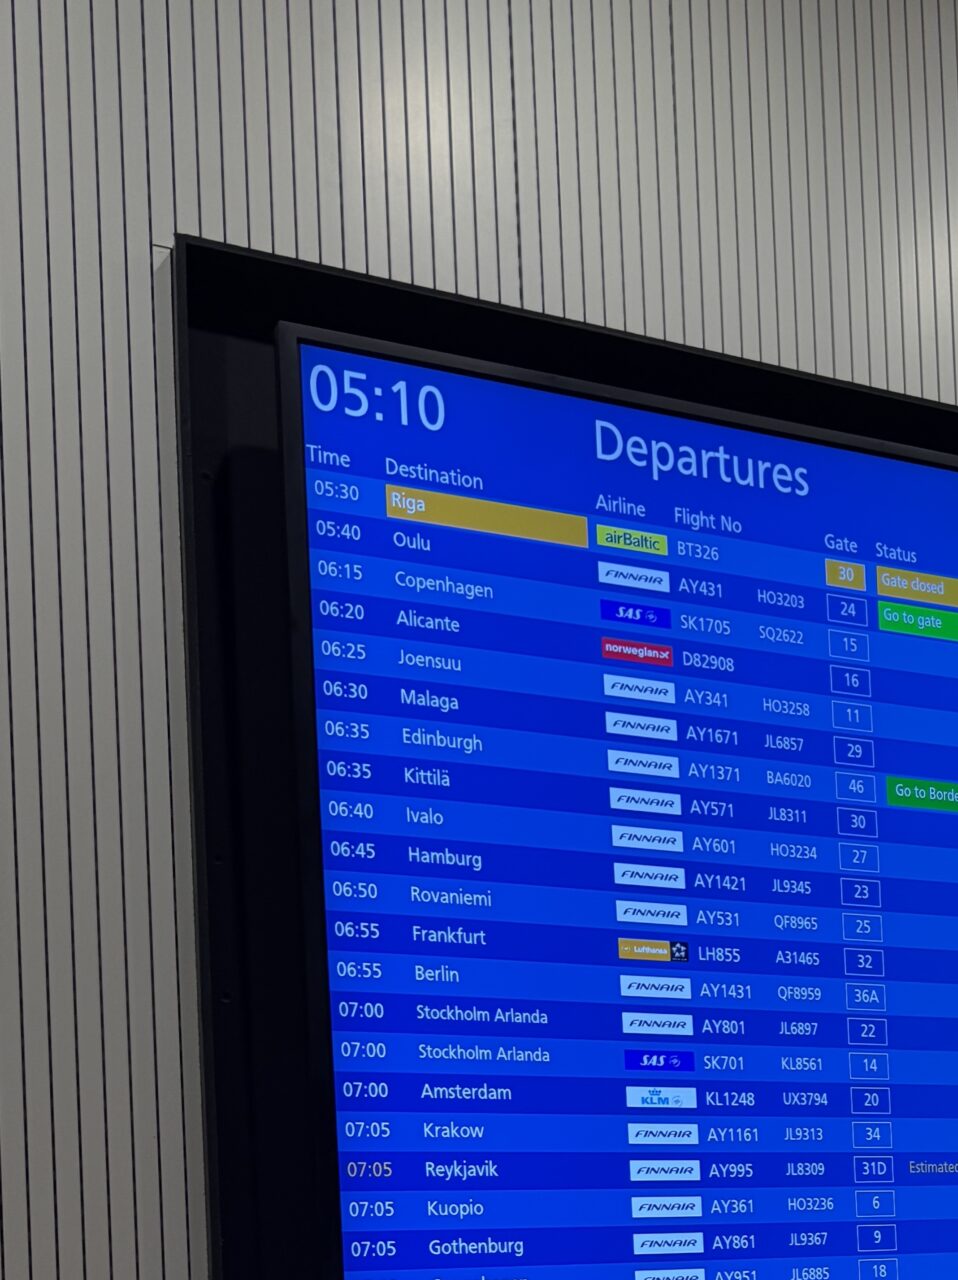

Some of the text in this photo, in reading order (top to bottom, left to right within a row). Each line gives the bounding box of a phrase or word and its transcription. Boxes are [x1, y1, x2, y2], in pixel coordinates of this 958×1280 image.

[309, 364, 446, 432] 05:10
[595, 419, 810, 497] Departures
[305, 444, 917, 563] Time Destination Airline Flight No Gate Status
[314, 479, 945, 595] 05:30 Riga airBaltic BT326 30 Gate closed
[316, 519, 942, 629] 05:40 Oulu FINNAIR AY431 HO3203 24 Go to gate
[324, 720, 370, 740] 06:35
[402, 727, 483, 754] Edinburgh
[614, 758, 674, 772] FINNAIR
[688, 762, 740, 782] AY1371
[766, 770, 812, 788] BA6020
[848, 779, 864, 794] 46
[895, 783, 911, 797] Go
[914, 786, 926, 799] to
[332, 880, 871, 934] 06:50 Rovaniemi FINNAIR AY531 QF8965 25
[340, 1041, 878, 1072] 07:00 Stockholm Arlanda SAS SK701 KL8561 14
[342, 1081, 879, 1107] 07:00 Amsterdam KLM KL1248 UX3794 20
[347, 1161, 393, 1178] 07:05
[425, 1159, 499, 1181] Reykjavik
[635, 1164, 695, 1177] FINNAIR
[708, 1163, 754, 1178] AY995
[785, 1162, 825, 1176] JL8309
[862, 1161, 887, 1175] 31D
